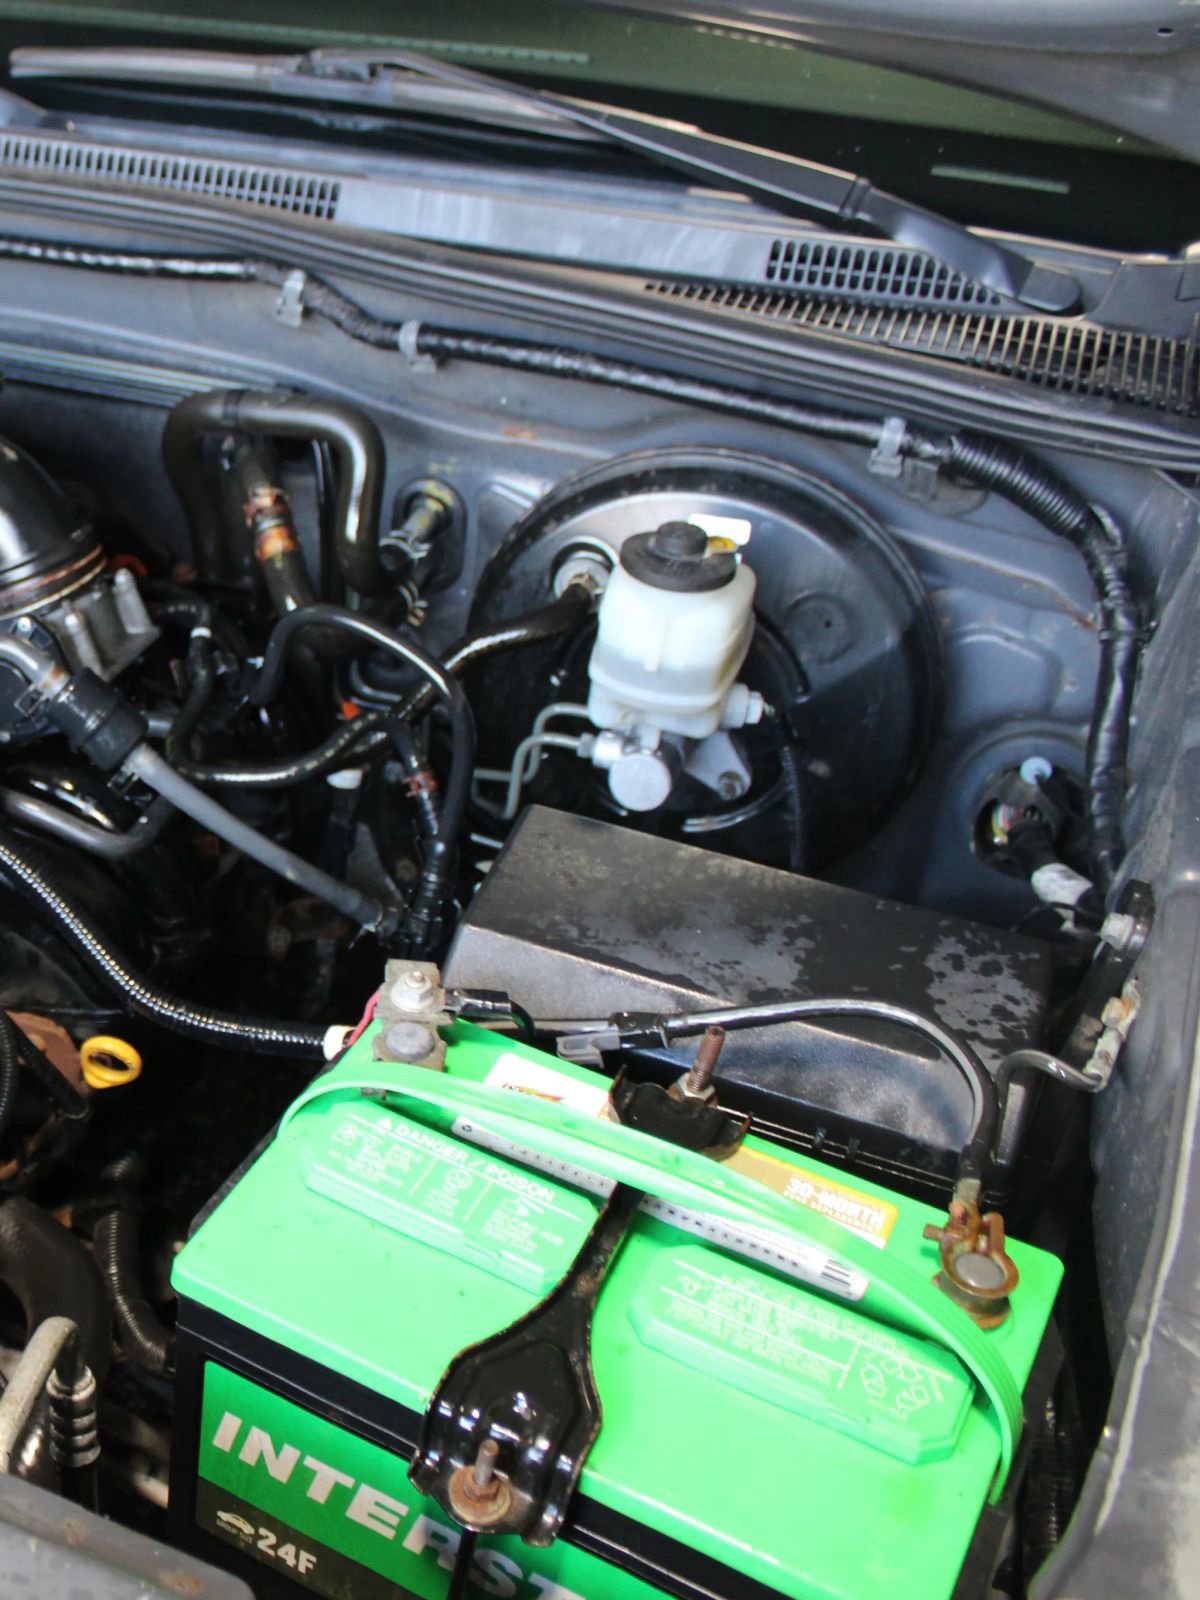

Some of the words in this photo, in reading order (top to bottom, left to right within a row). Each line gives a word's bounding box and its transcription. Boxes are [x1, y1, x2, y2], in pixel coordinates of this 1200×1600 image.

[395, 1123, 470, 1164] DANGER
[484, 1163, 556, 1202] POISON
[257, 1526, 317, 1575] 24F
